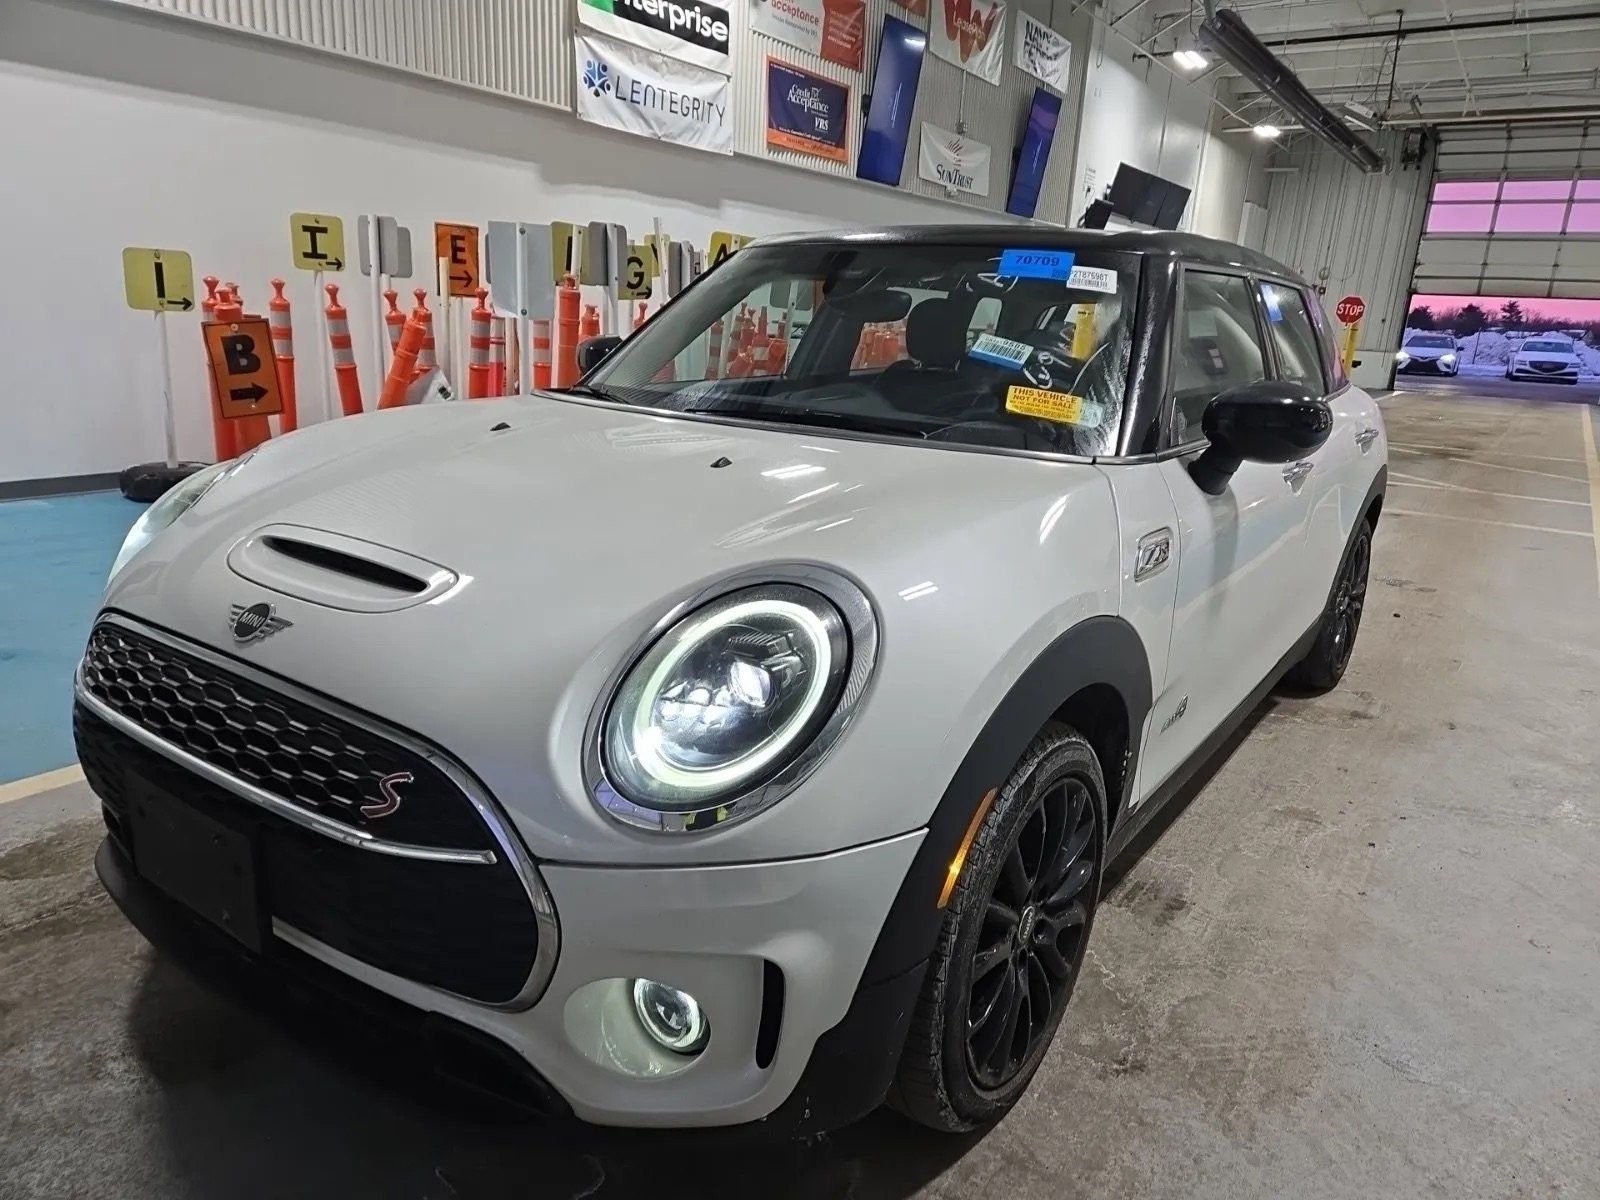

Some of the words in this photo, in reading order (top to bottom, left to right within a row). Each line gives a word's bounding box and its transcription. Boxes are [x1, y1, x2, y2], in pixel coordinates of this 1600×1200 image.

[787, 88, 829, 113] Acceptance
[814, 116, 829, 131] VRS
[451, 234, 467, 265] E
[1015, 254, 1060, 267] 70709
[626, 256, 645, 290] G
[1337, 303, 1364, 316] STOP
[220, 333, 261, 376] B
[1012, 394, 1030, 402] NOT
[1033, 397, 1050, 405] FOR
[1052, 400, 1074, 410] SALE
[1013, 387, 1035, 397] THIS
[1037, 390, 1077, 404] VEHICLE
[240, 611, 266, 628] MINI
[360, 771, 415, 819] S
